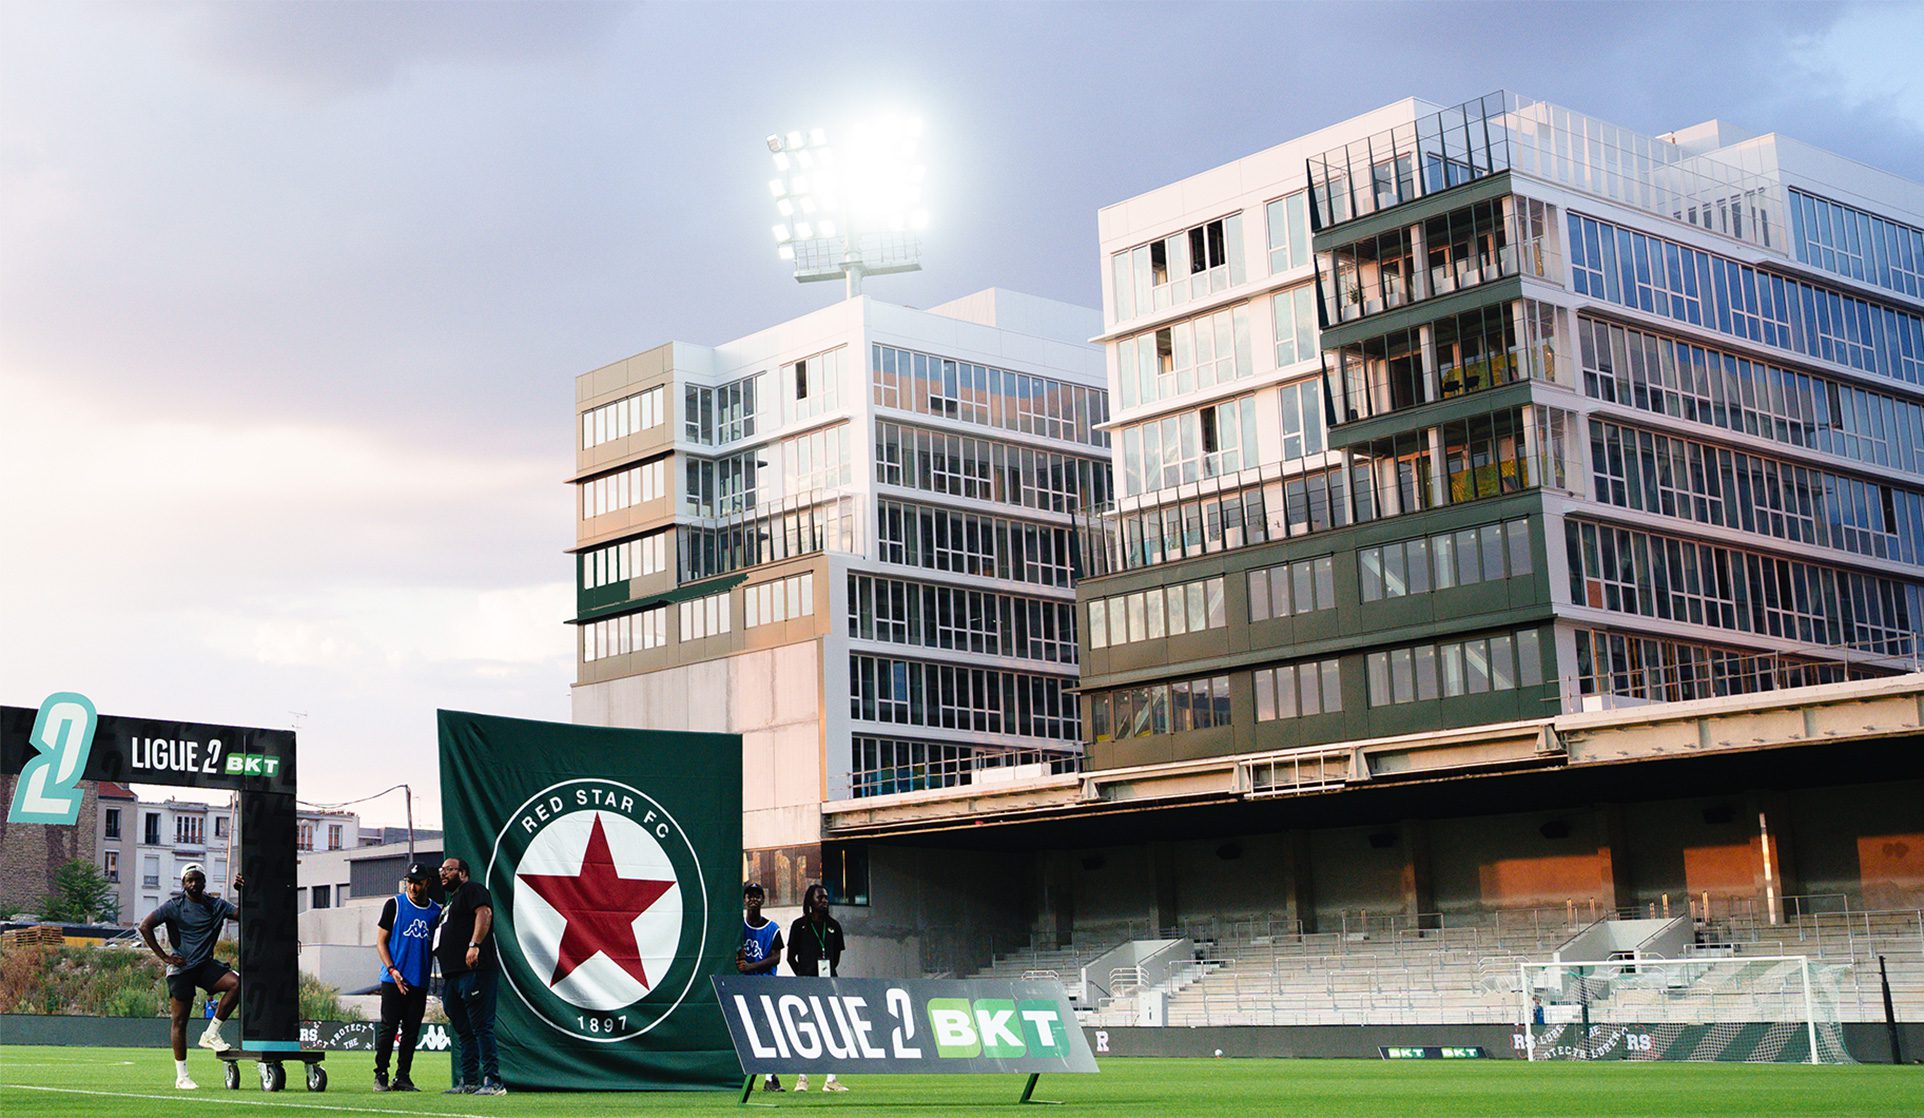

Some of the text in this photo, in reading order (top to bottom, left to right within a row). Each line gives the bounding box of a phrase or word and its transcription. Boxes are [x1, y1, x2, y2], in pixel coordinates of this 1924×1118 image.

[132, 736, 278, 774] LIGUE 2 BKT
[522, 789, 669, 838] RED STAR FC
[577, 1015, 627, 1033] 1897
[733, 988, 1058, 1059] LIGUE 2 BKT
[300, 1028, 318, 1042] RS
[330, 1023, 368, 1047] PROTECT
[343, 1037, 359, 1049] THE
[1626, 1034, 1651, 1050] RS
